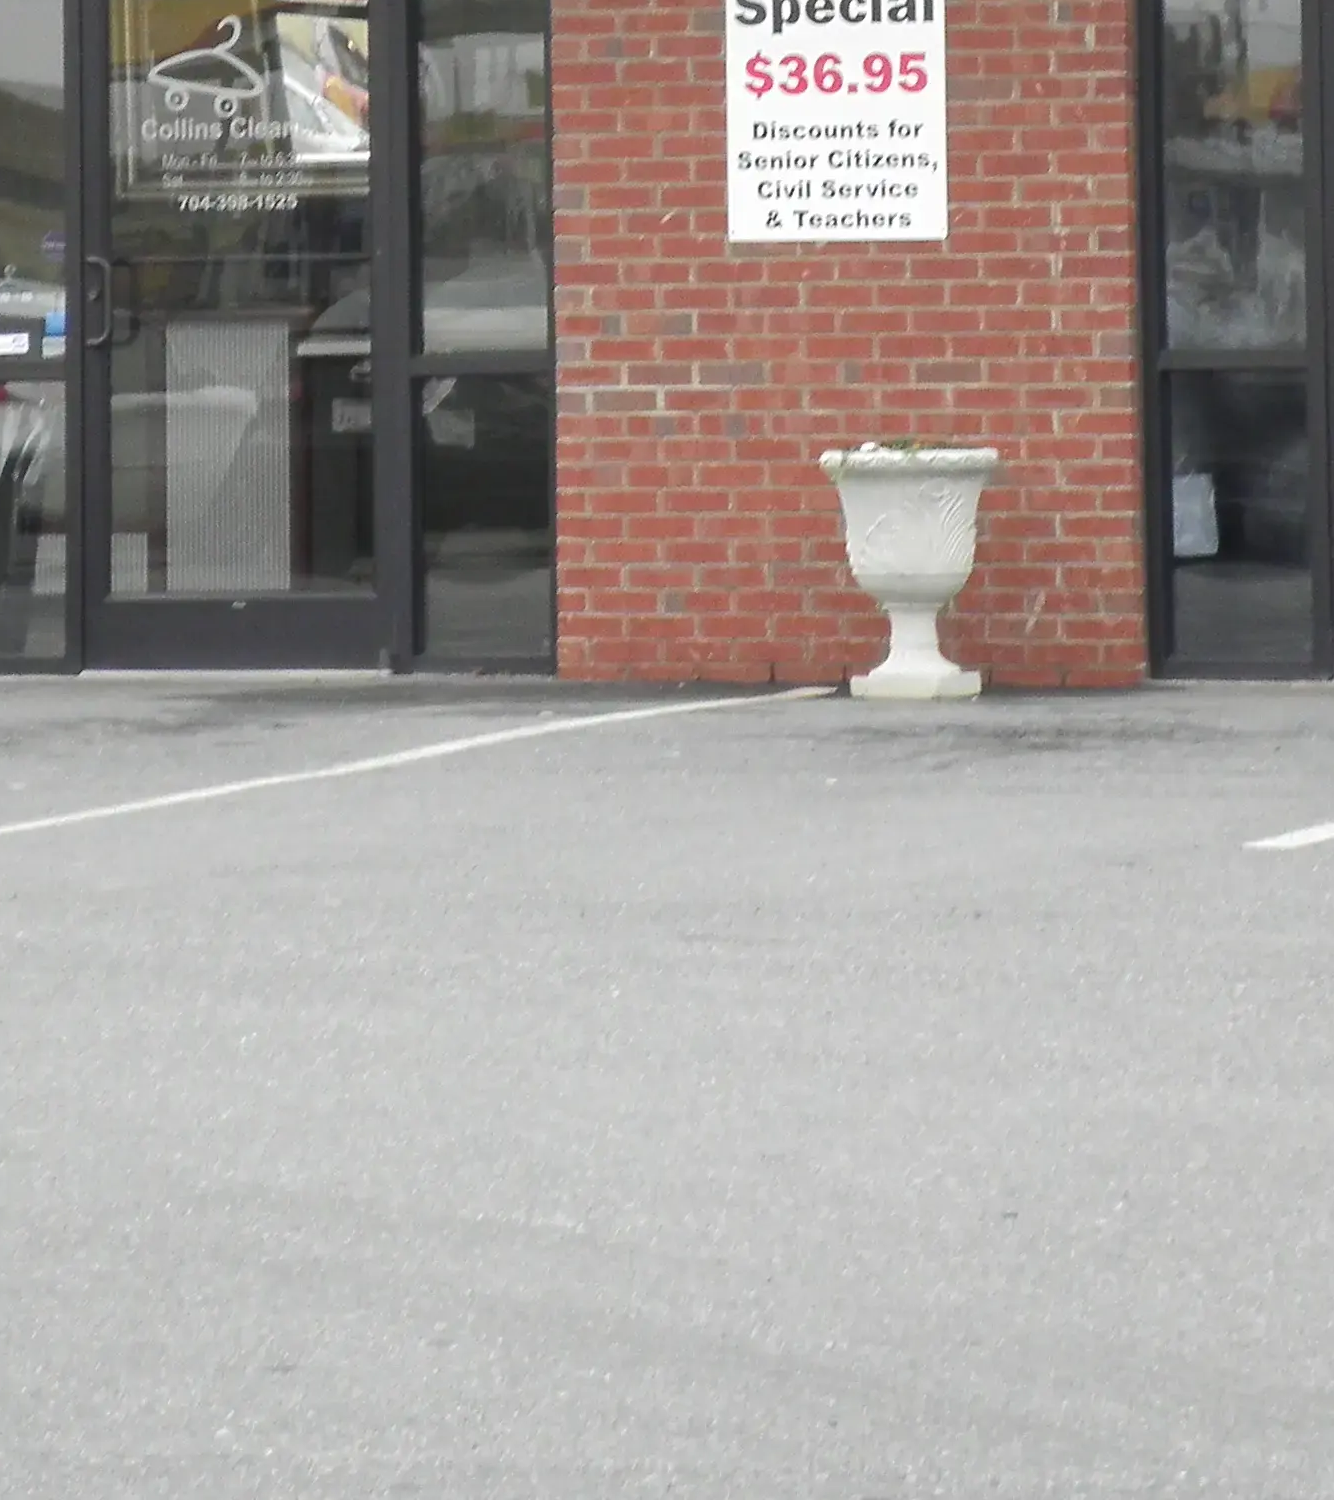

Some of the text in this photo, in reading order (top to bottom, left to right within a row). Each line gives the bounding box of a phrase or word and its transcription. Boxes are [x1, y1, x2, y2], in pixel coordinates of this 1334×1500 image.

[744, 50, 929, 100] $36.95
[141, 115, 223, 142] Collins
[751, 118, 924, 141] Discounts for
[737, 148, 939, 174] Senior Citizens,
[757, 178, 919, 200] Civil Service
[764, 209, 913, 229] & Teachers
